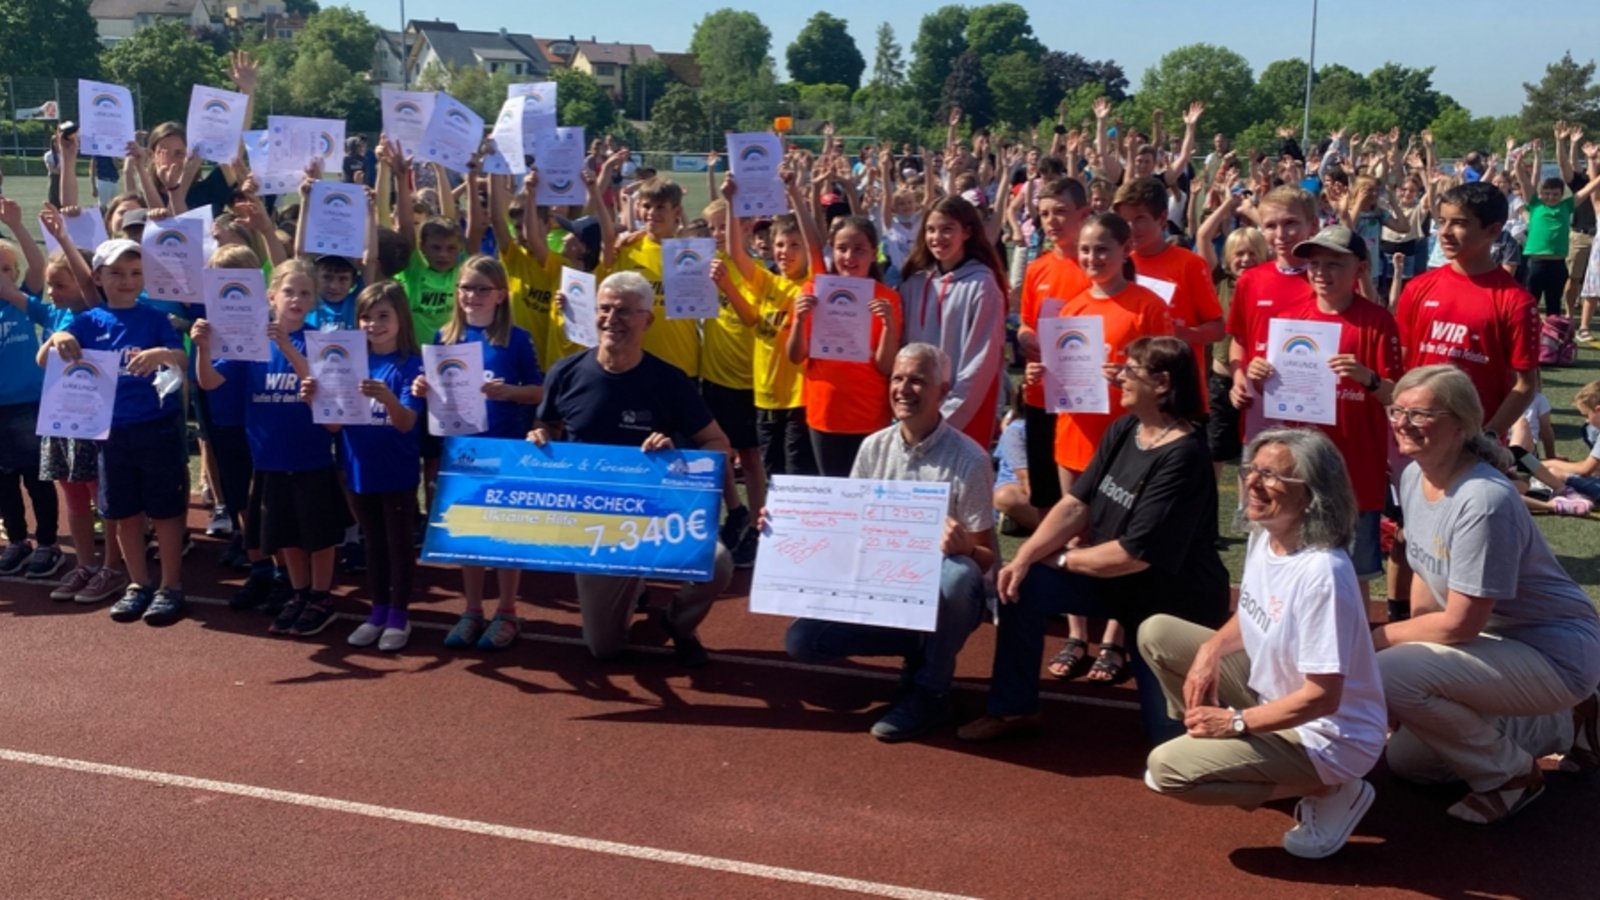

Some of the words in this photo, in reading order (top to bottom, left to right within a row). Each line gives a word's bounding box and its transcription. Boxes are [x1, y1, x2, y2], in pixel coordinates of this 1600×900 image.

[1431, 320, 1468, 344] WIR
[1283, 359, 1320, 370] URKUNDE
[265, 372, 299, 391] WIR
[484, 488, 647, 514] BZ-SPENDEN-SCHECK
[483, 509, 540, 524] Ukraine
[584, 508, 709, 557] 7.340€
